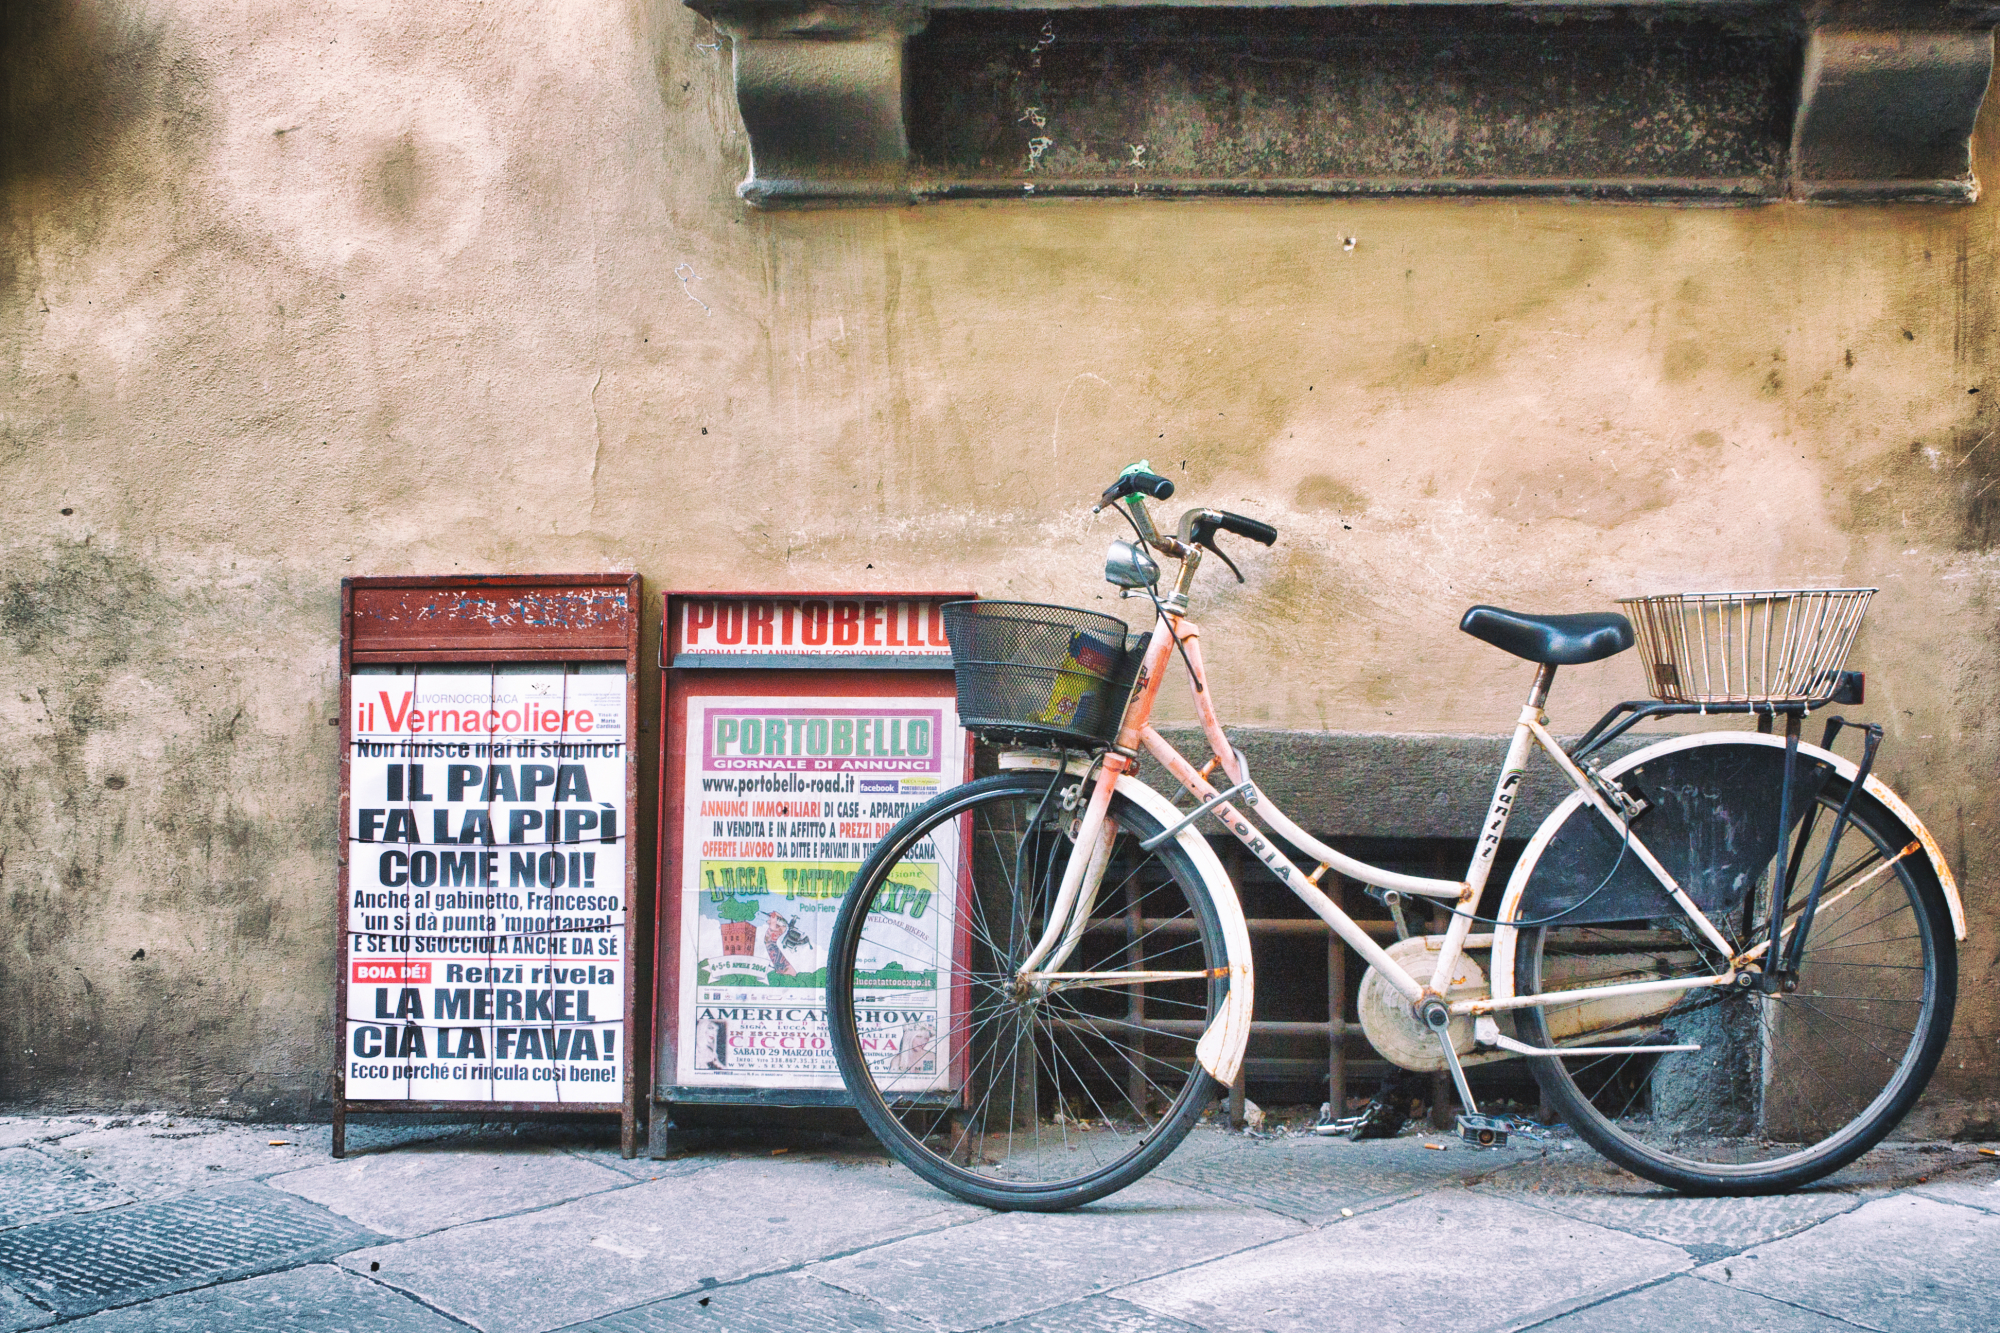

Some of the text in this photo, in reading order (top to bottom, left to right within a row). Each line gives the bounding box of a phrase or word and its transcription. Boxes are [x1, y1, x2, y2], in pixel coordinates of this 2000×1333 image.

[687, 600, 950, 646] PORTOBELLO
[416, 694, 518, 704] LIVORNOCRONACA
[358, 690, 594, 732] il Vernacoliere
[716, 718, 930, 756] PORTOBELLO
[358, 738, 620, 761] Non finisce mai di stupirci
[714, 760, 930, 770] GIORNALE DI ANNUNCI
[387, 764, 593, 802] IL PAPA
[702, 772, 854, 797] www.portobello-road.it
[860, 784, 894, 792] facebook
[700, 800, 748, 817] ANNUNCI
[752, 801, 820, 818] IMMOBILIARI
[824, 802, 834, 818] DI
[837, 802, 860, 818] CASE
[358, 802, 617, 845] FA LA PIPÌ
[713, 820, 724, 837] IN
[727, 820, 766, 837] VENDITA
[768, 821, 774, 837] E
[776, 821, 787, 838] IN
[790, 822, 826, 838] AFFITTO
[829, 822, 836, 838] A
[840, 822, 872, 838] PREZZI
[702, 840, 737, 858] OFFERTE
[740, 841, 774, 858] LAVORO
[777, 842, 788, 858] DA
[790, 842, 810, 858] DITTE
[814, 842, 818, 858] E
[820, 842, 848, 858] PRIVATI
[852, 842, 860, 859] IN
[902, 843, 936, 860] OSCANA
[379, 850, 596, 888] COME NOI!
[706, 866, 770, 902] LUCCA
[354, 890, 619, 912] Anche al gabinetto, Francesco
[800, 903, 836, 912] Polo Fiere
[394, 912, 410, 930] si
[416, 912, 438, 931] dà
[443, 914, 496, 932] punta
[867, 915, 930, 941] WELCOME BIKERS
[354, 934, 618, 956] E SE LO SGOCCIOLA ANCHE DA SÉ
[358, 964, 426, 978] BOIA DÉ!
[446, 964, 614, 985] Renzi rivela
[752, 962, 767, 973] 2014
[854, 977, 932, 988] .luccatattooexpo.it
[376, 988, 596, 1021] LA MERKEL
[855, 1010, 924, 1022] SHOW
[353, 1020, 616, 1061] CIÀ LA FAVA!
[728, 1036, 898, 1051] CICCIONA
[733, 1048, 766, 1056] SABATO
[768, 1048, 780, 1056] 29
[782, 1048, 813, 1056] MARZO
[352, 1063, 616, 1082] Ecco perché ci rincula così bene!
